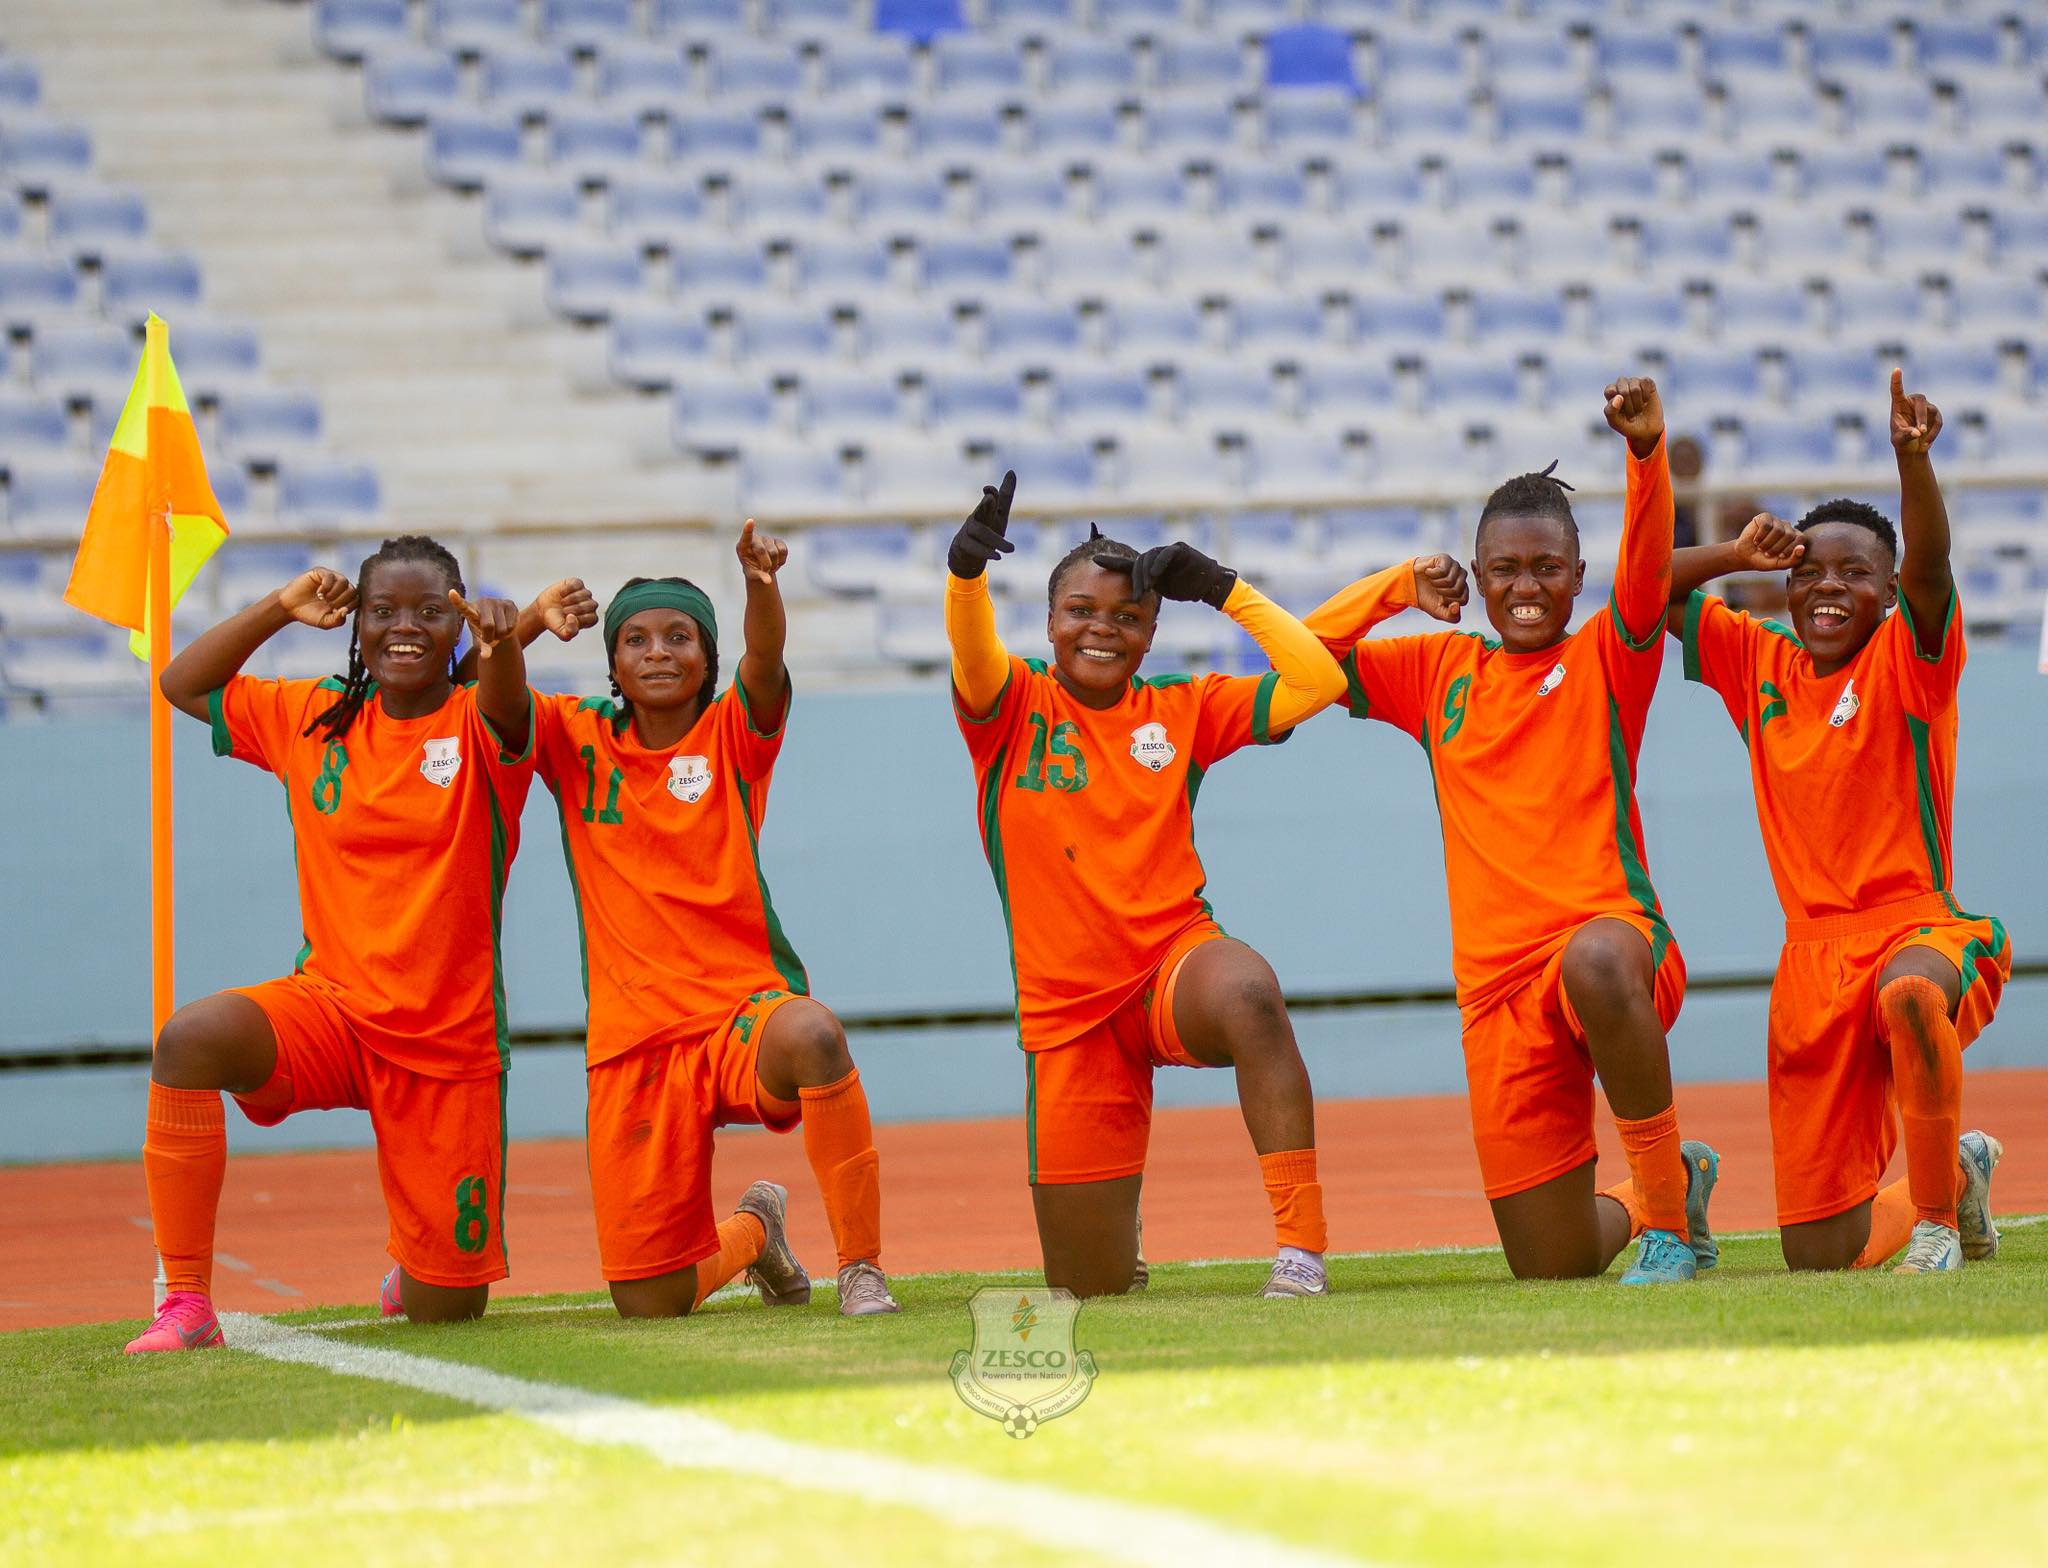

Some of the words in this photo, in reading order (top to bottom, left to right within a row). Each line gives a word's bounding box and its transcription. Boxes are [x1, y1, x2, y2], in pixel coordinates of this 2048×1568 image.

[1439, 673, 1472, 745] 9
[312, 739, 349, 815] 8
[432, 757, 455, 768] ZESCO
[678, 774, 704, 785] ZESCO
[1016, 712, 1088, 793] 15
[1141, 742, 1165, 751] ZESCO
[580, 745, 624, 825] 11
[454, 1174, 489, 1254] 8
